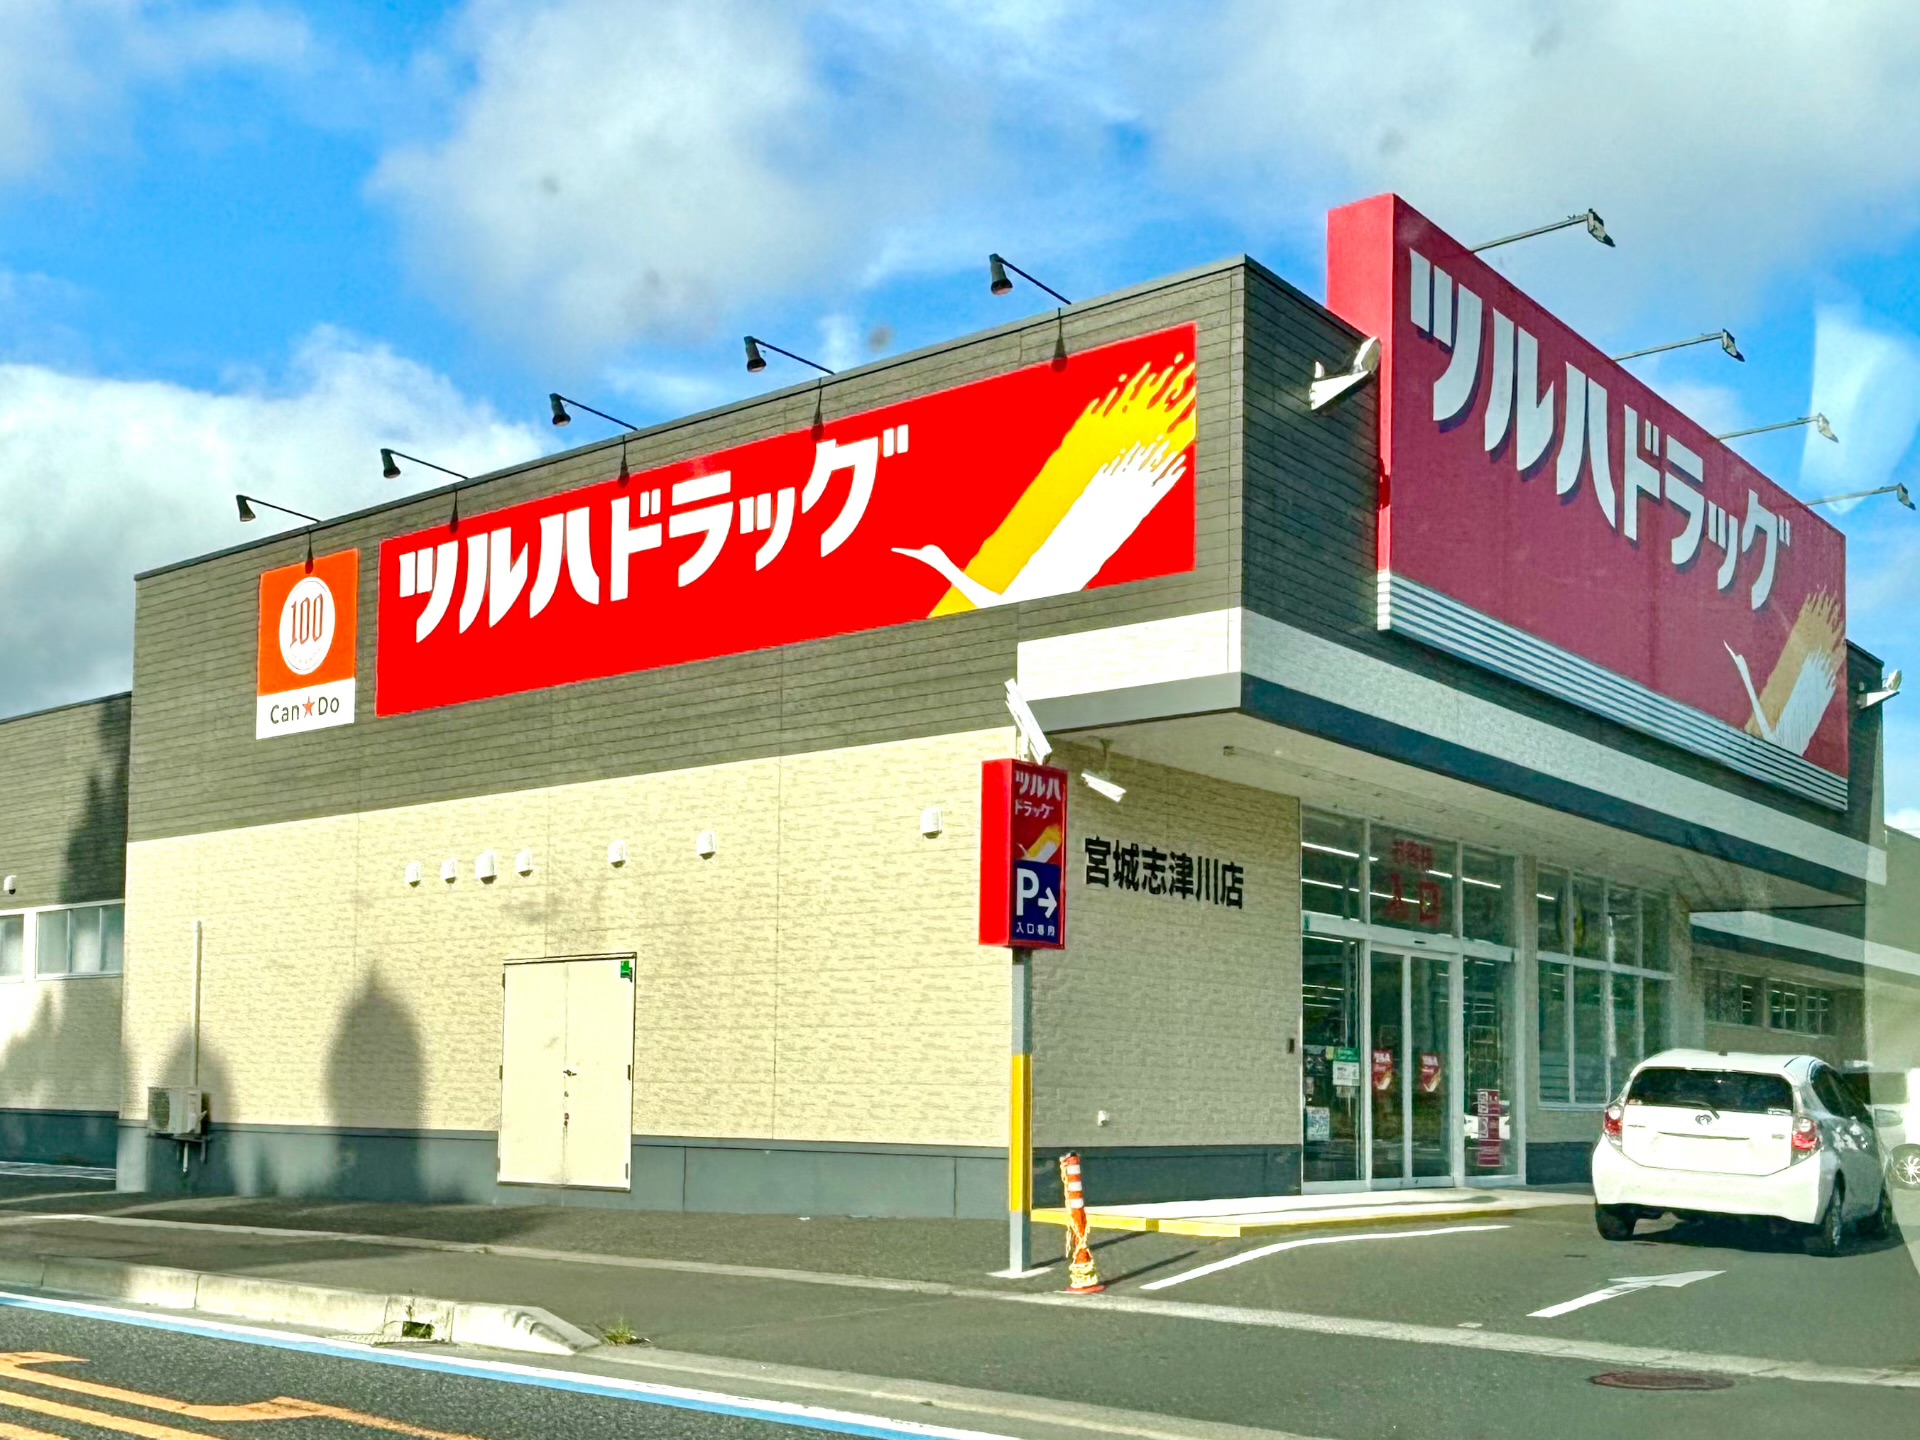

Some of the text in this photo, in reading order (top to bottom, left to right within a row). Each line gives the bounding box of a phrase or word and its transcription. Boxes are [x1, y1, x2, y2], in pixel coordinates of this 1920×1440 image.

[1411, 248, 1790, 610] ツルハドラッグ
[399, 424, 909, 643] ツルハドラッグ
[290, 594, 324, 648] 100
[1014, 799, 1055, 820] ドラッグ
[1015, 770, 1061, 801] ツルハ
[1016, 868, 1040, 916] P
[1084, 836, 1244, 910] 宮城志津川店
